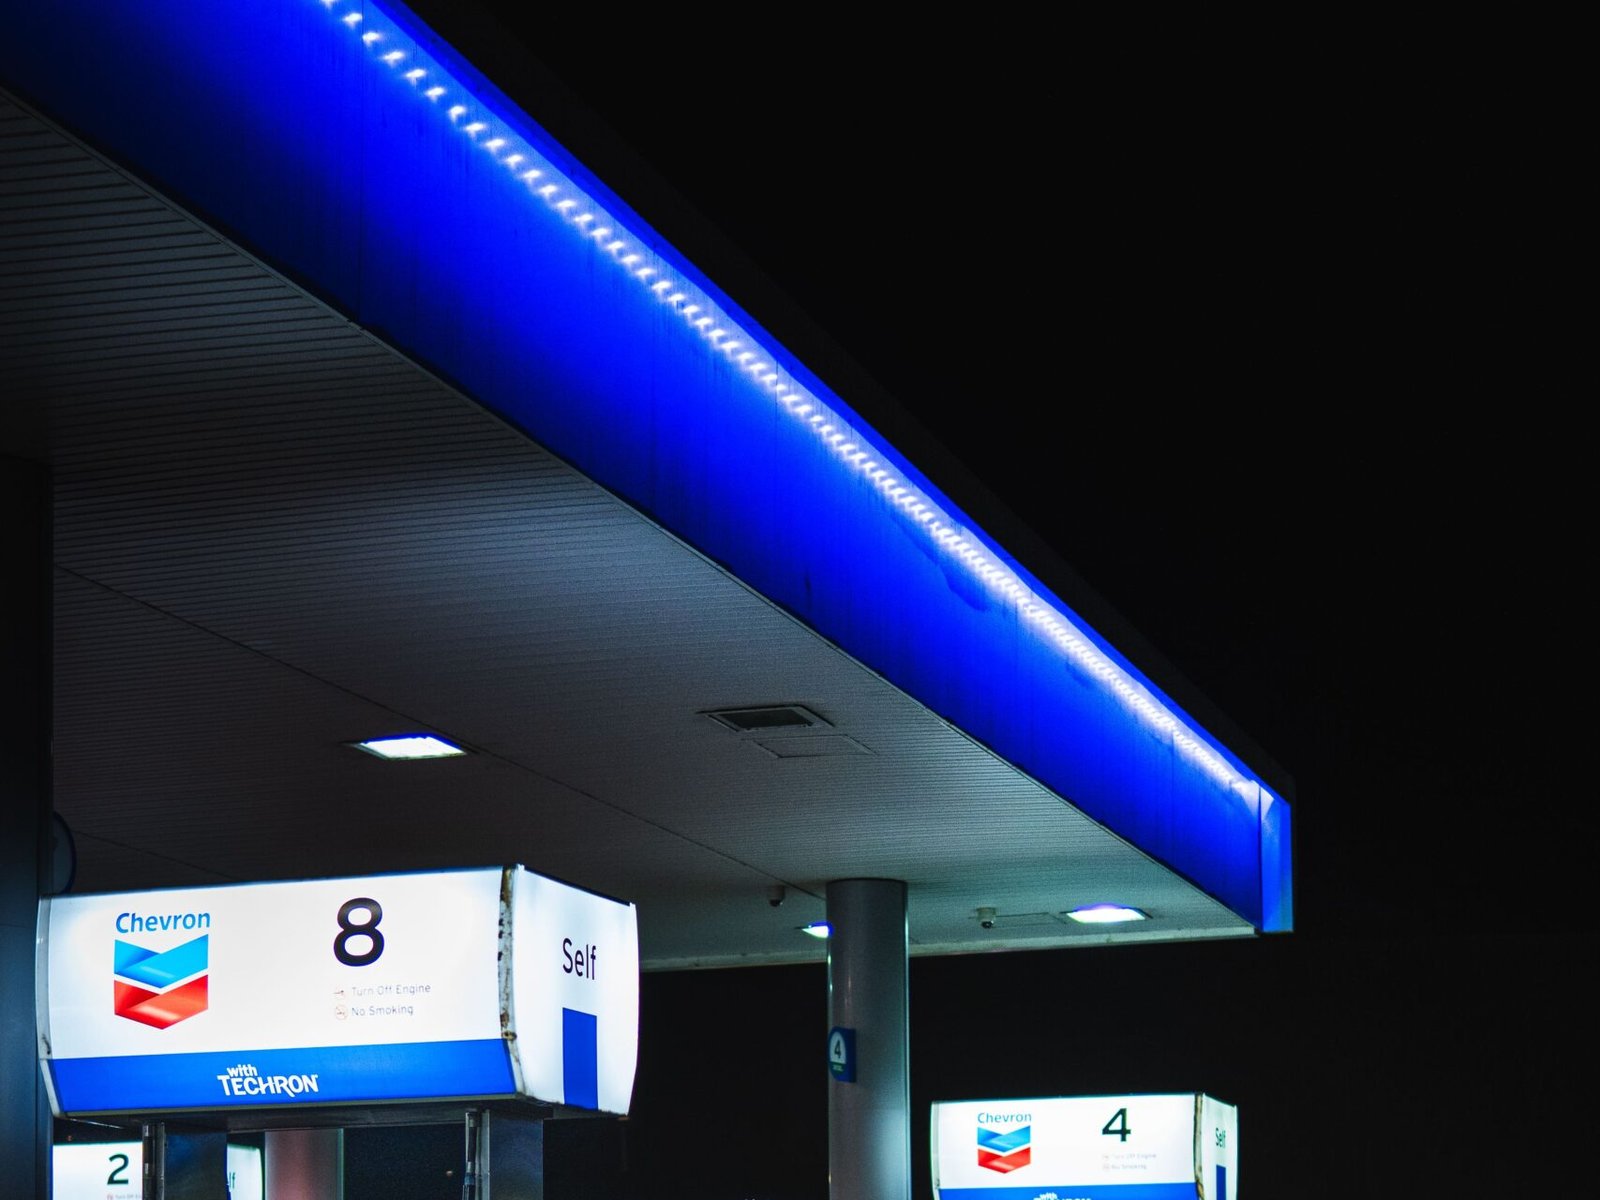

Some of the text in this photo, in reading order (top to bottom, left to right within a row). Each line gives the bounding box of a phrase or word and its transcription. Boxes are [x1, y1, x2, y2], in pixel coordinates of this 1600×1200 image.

[115, 911, 211, 935] Chevron
[333, 897, 386, 967] 8
[562, 937, 598, 981] Self
[352, 985, 431, 997] Turn Off Engine
[352, 1005, 414, 1016] No Smoking
[834, 1040, 842, 1059] 4
[227, 1064, 258, 1077] with
[217, 1074, 319, 1098] TECHRON
[977, 1112, 1032, 1124] Chevron
[1102, 1108, 1131, 1142] 4
[1215, 1127, 1226, 1149] Self
[107, 1153, 129, 1185] 2
[1040, 1192, 1058, 1200] with
